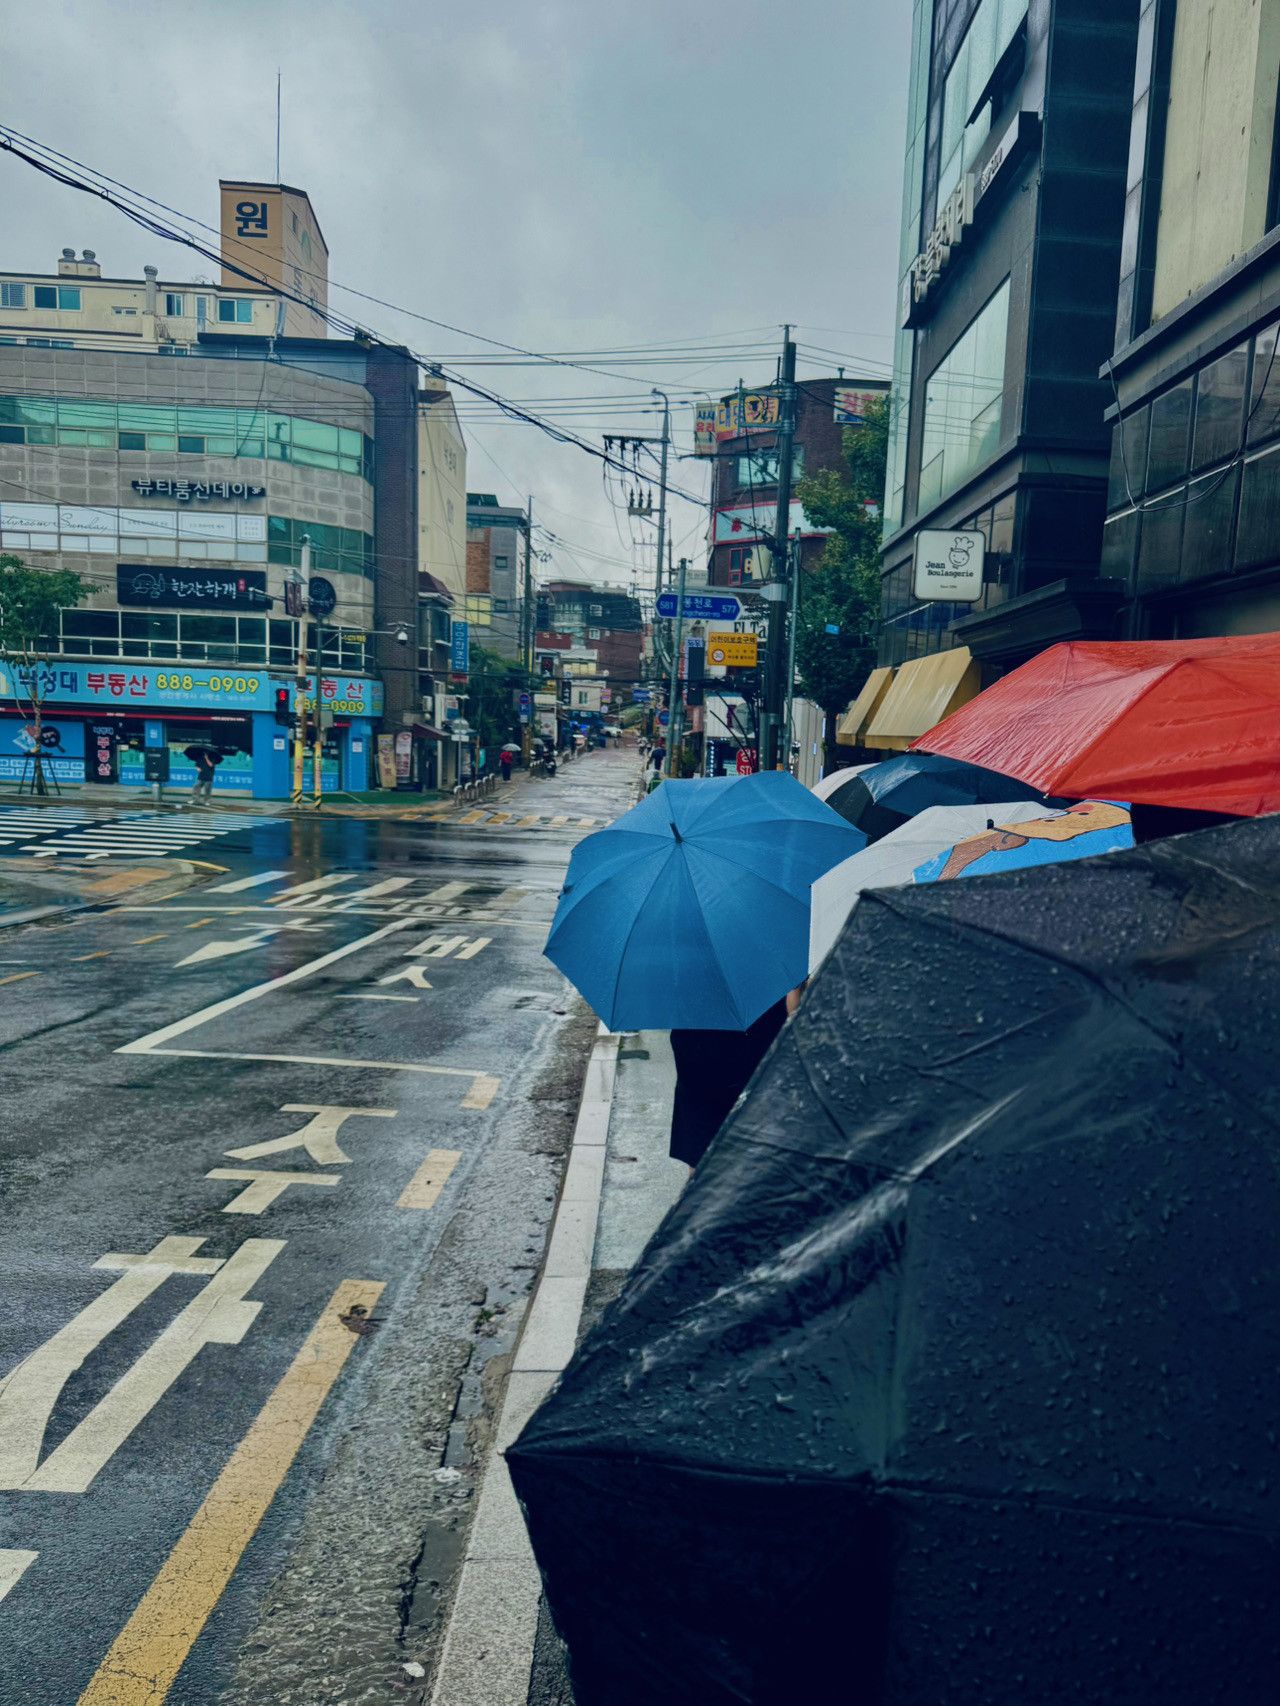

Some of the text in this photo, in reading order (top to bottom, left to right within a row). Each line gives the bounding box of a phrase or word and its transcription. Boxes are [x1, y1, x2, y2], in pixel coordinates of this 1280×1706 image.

[235, 201, 268, 239] 원
[136, 478, 248, 500] 뷰티룸선데이
[926, 561, 946, 569] Jean
[927, 569, 974, 578] Boulangerie
[660, 600, 674, 610] 581
[722, 604, 737, 614] 577
[87, 672, 148, 697] 부동산
[156, 673, 260, 694] 888-0909
[334, 934, 493, 1003] 버스
